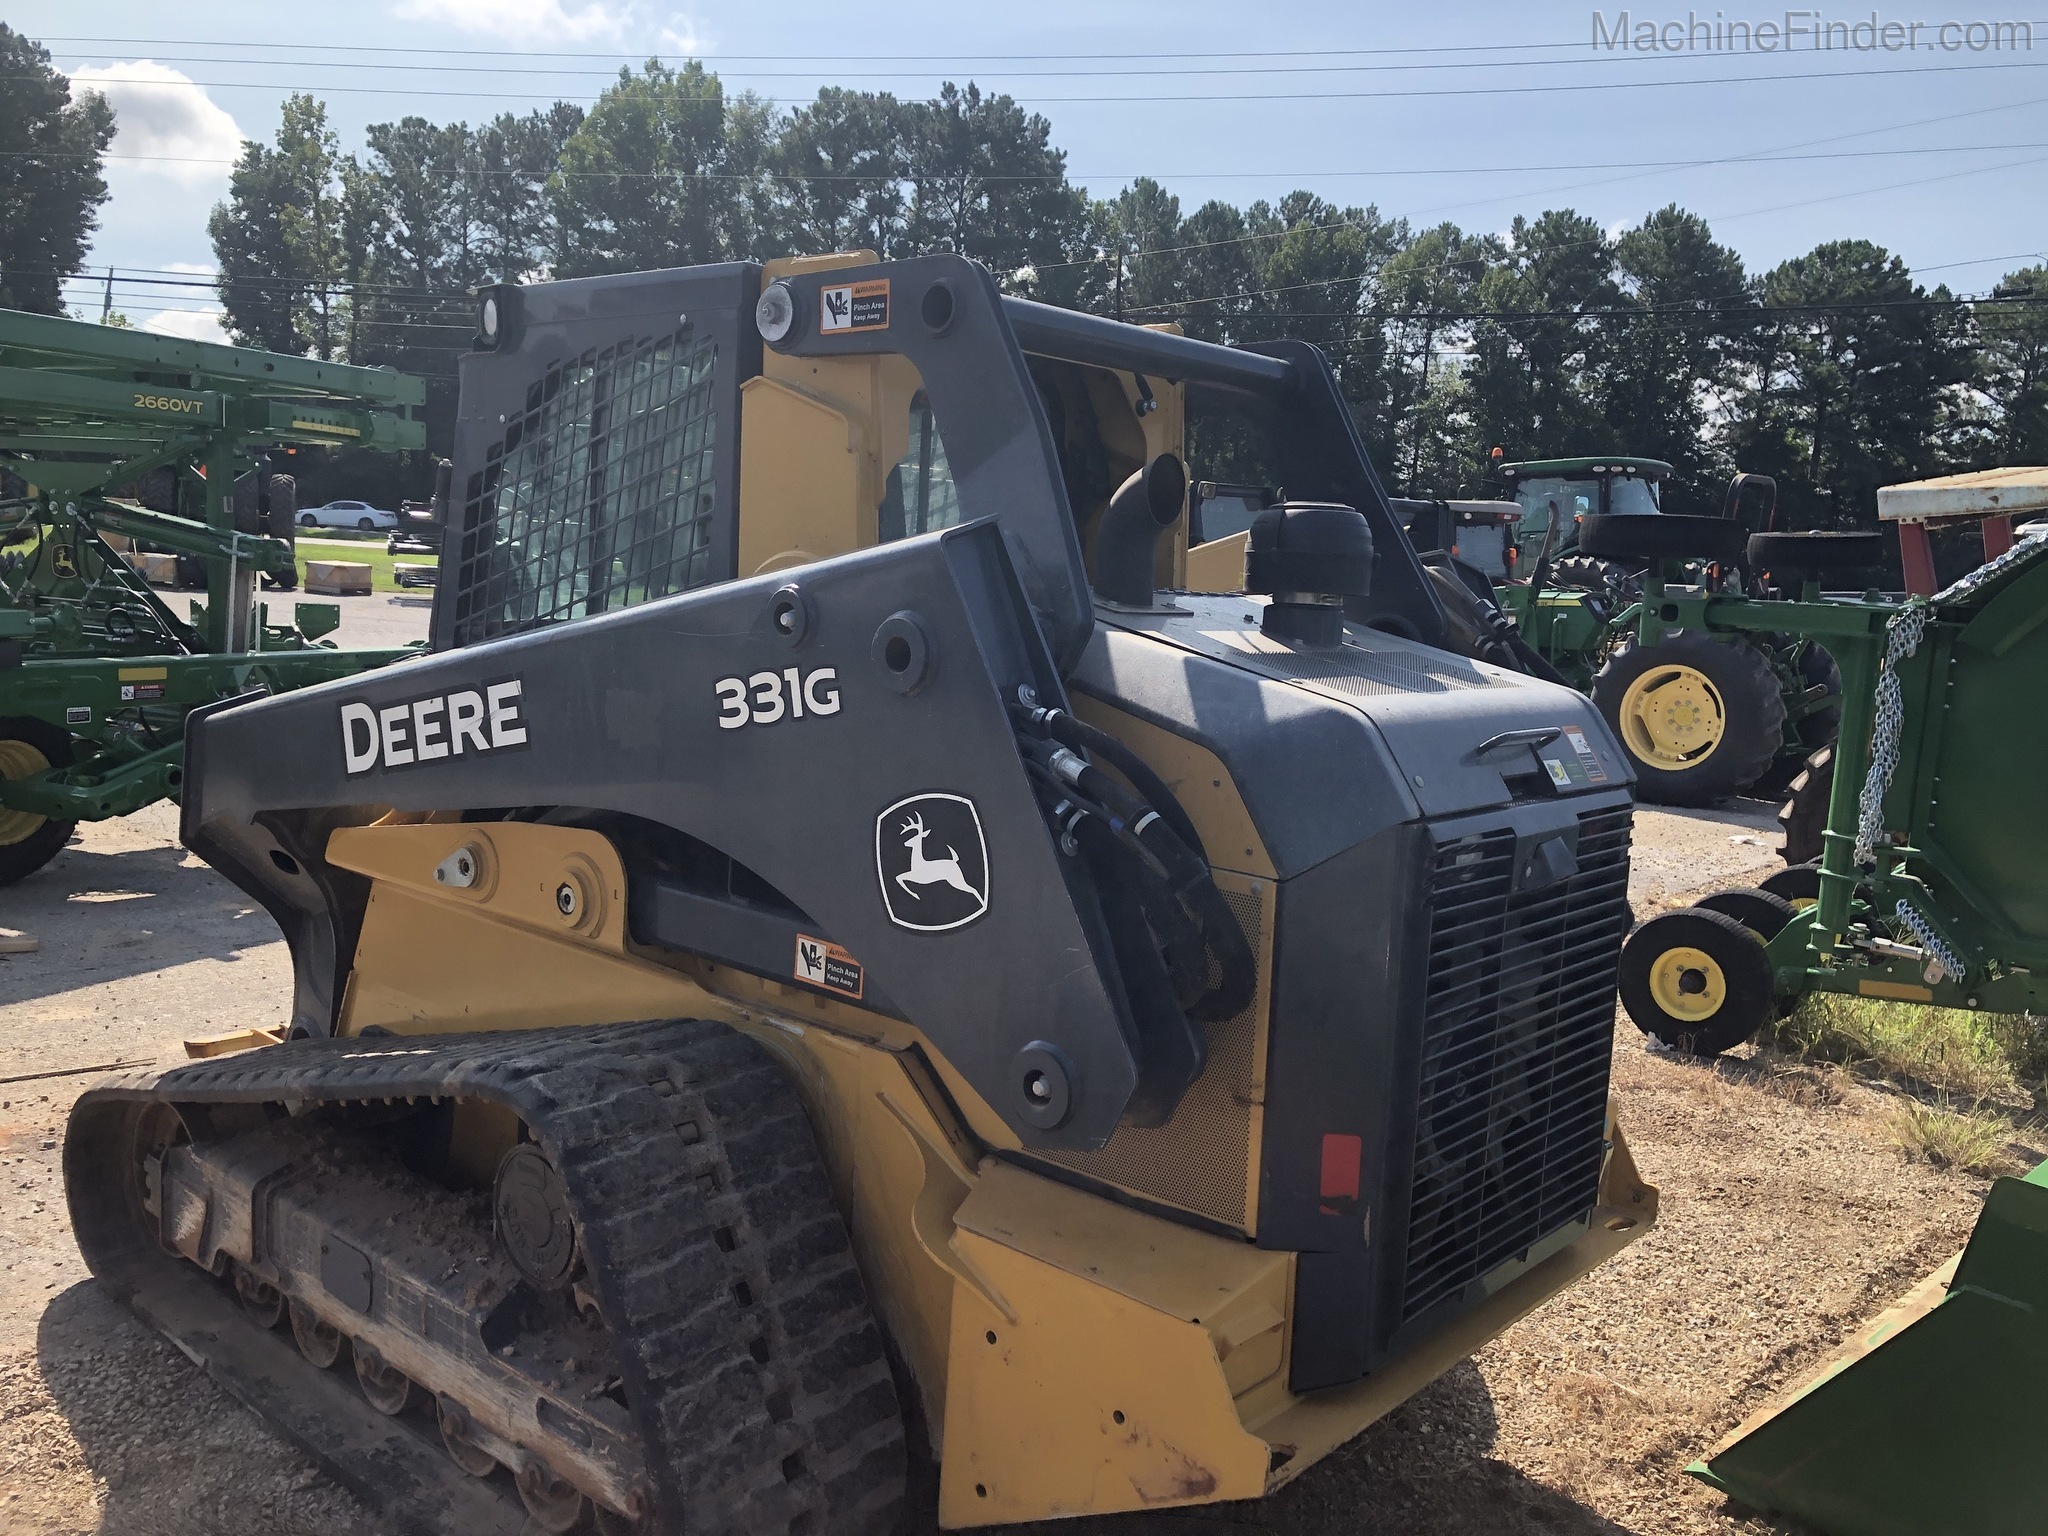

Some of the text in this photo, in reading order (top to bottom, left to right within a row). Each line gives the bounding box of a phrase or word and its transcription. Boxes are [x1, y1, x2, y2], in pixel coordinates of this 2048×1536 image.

[853, 301, 885, 312] Pinch Area
[853, 313, 880, 322] Keep Away
[133, 394, 204, 414] 2660VT
[715, 667, 841, 729] 331G
[341, 679, 527, 774] DEERE
[827, 963, 858, 979] Pinch Area
[827, 973, 853, 988] Keep Away
